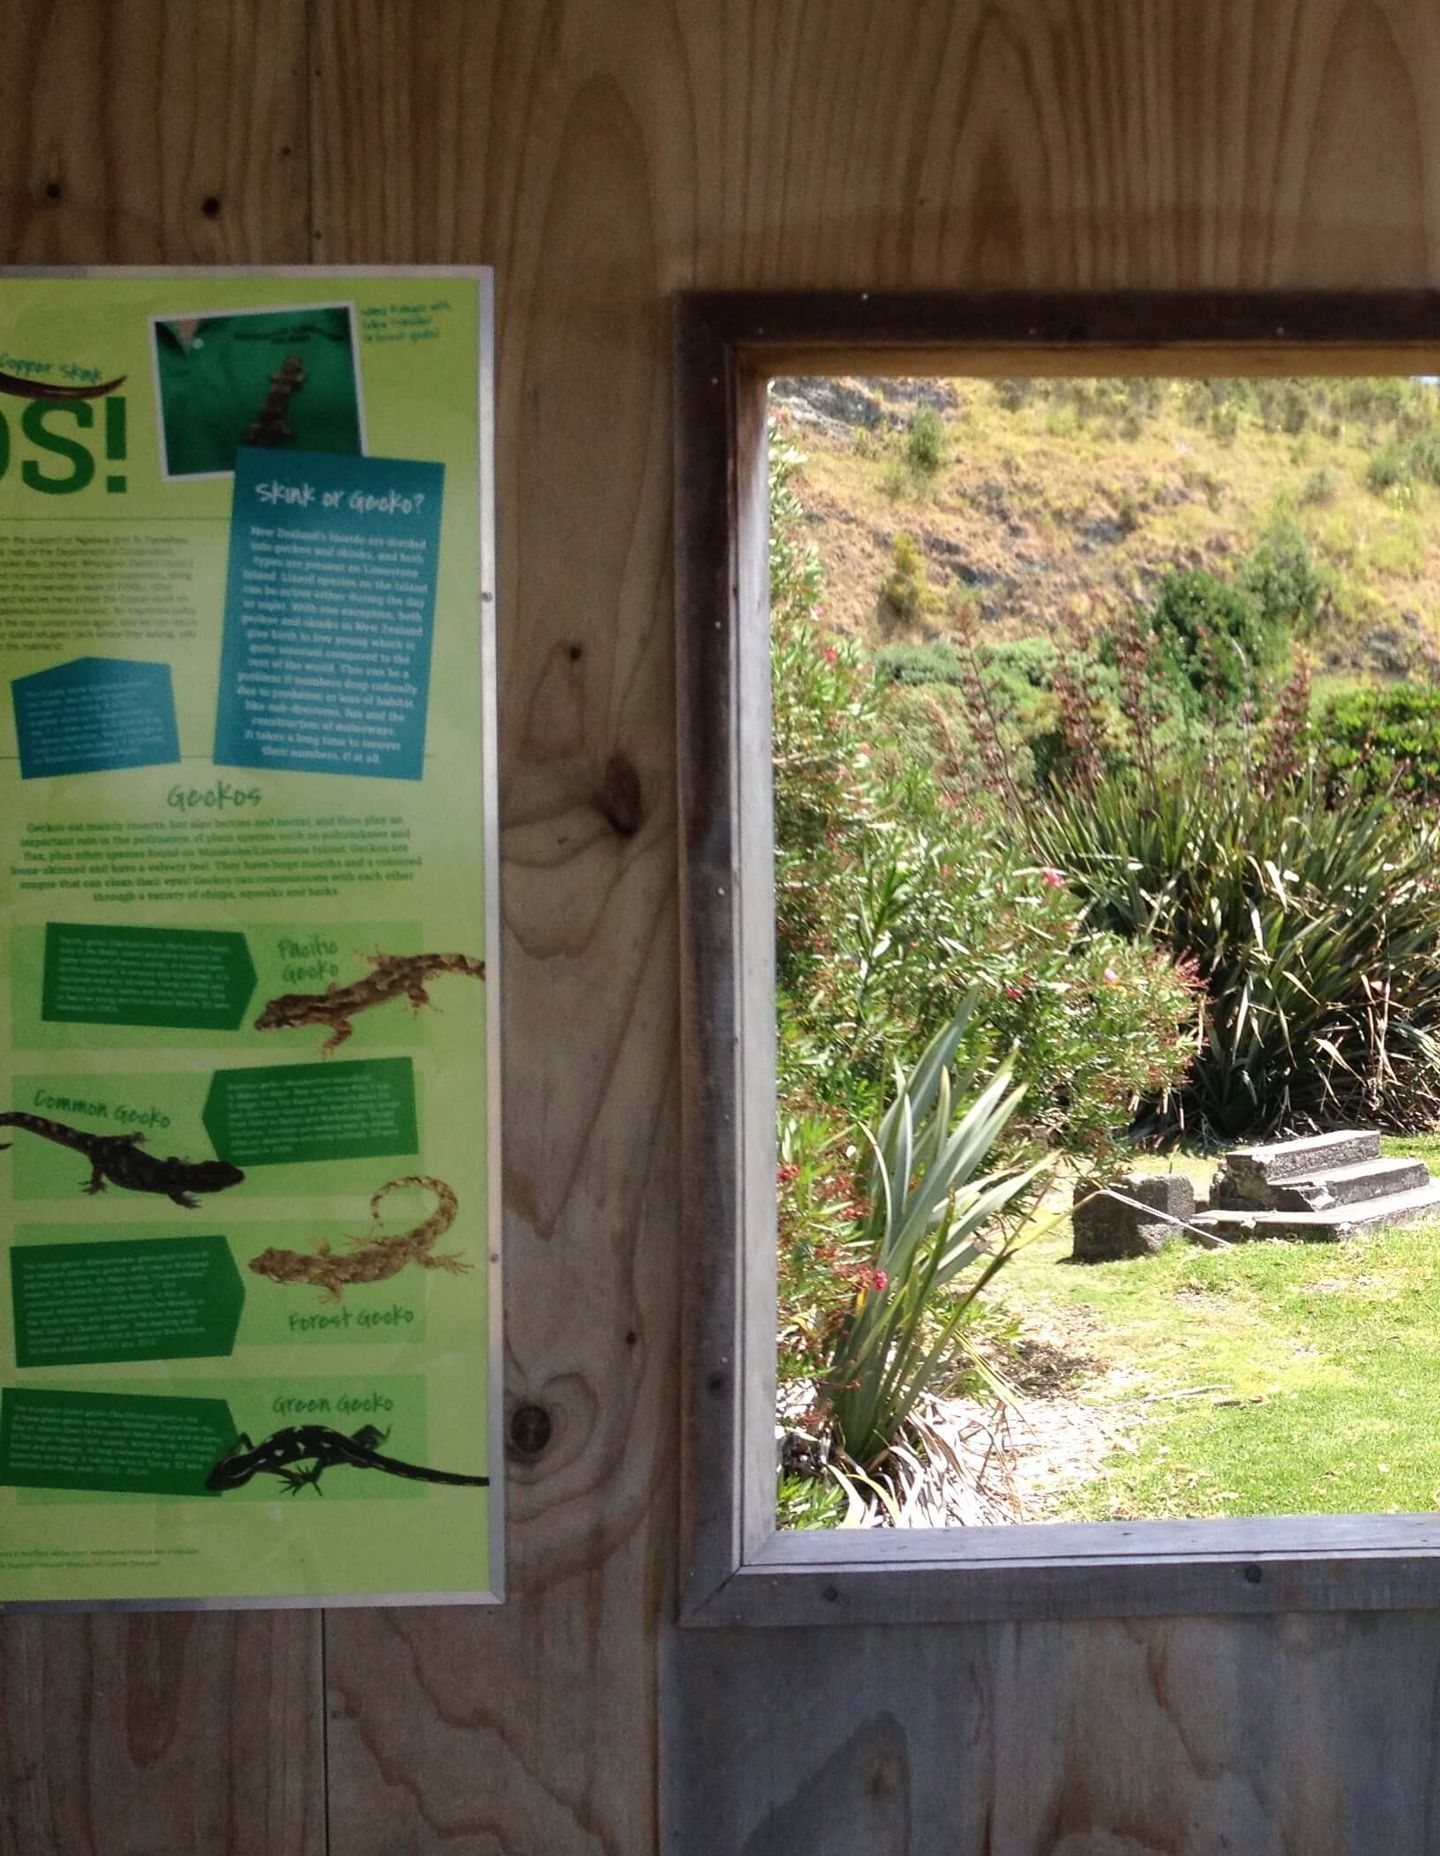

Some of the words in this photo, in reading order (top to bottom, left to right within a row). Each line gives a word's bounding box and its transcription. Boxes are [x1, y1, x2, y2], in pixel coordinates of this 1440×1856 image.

[0, 397, 127, 494] S!
[254, 480, 316, 507] Skink
[322, 489, 345, 508] or
[348, 488, 425, 515] Gecko?
[167, 779, 263, 811] Geckos
[282, 958, 339, 985] Gecko
[34, 1089, 107, 1119] Common
[114, 1104, 170, 1128] Gecko
[288, 1306, 352, 1331] Forest
[356, 1304, 414, 1328] Gecko
[272, 1396, 331, 1416] Green
[336, 1392, 394, 1414] Gecko
